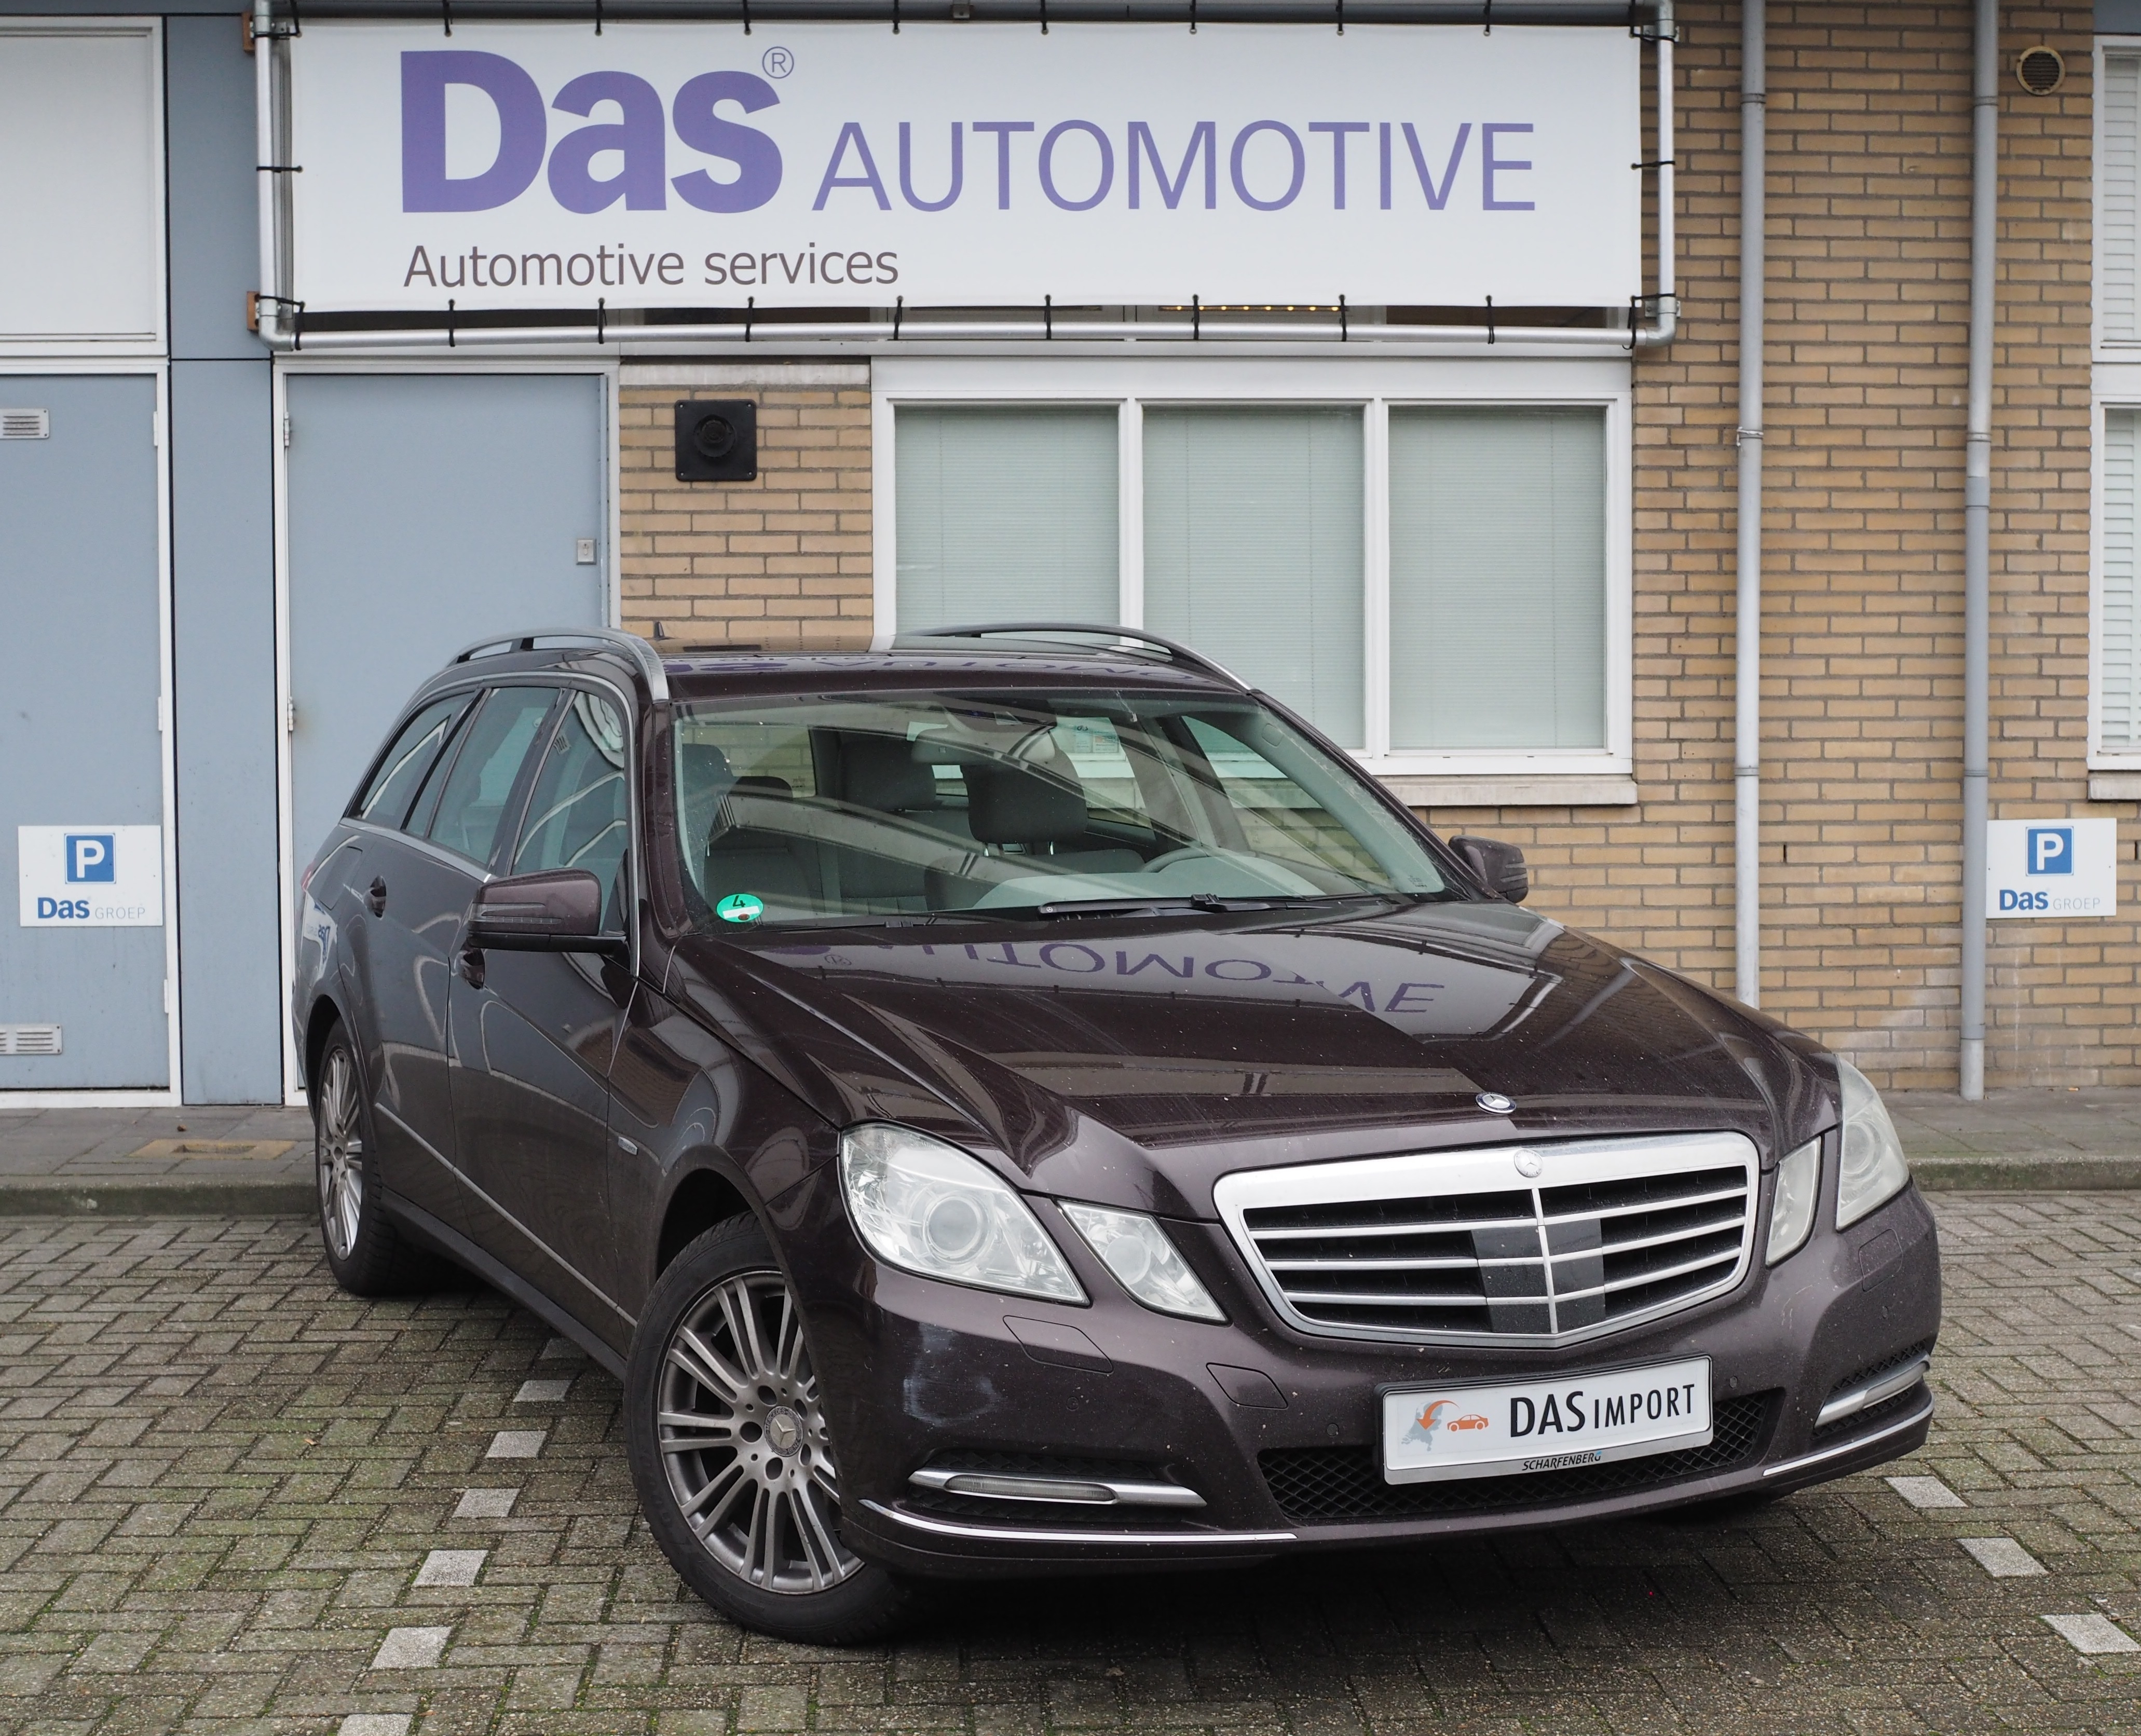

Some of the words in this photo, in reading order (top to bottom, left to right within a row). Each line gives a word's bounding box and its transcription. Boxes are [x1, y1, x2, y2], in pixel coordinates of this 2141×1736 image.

[811, 119, 1535, 213] AUTOMOTIVE
[403, 243, 685, 288] Automotive
[703, 242, 898, 285] services
[76, 839, 105, 879] P
[2036, 832, 2064, 871] P
[37, 897, 90, 919] Das
[94, 906, 145, 920] GROEP
[732, 895, 746, 908] 4
[1999, 889, 2049, 911] Das
[2053, 897, 2101, 910] GROEP
[1510, 1391, 1586, 1438] DAS
[1593, 1384, 1695, 1429] IMPORT
